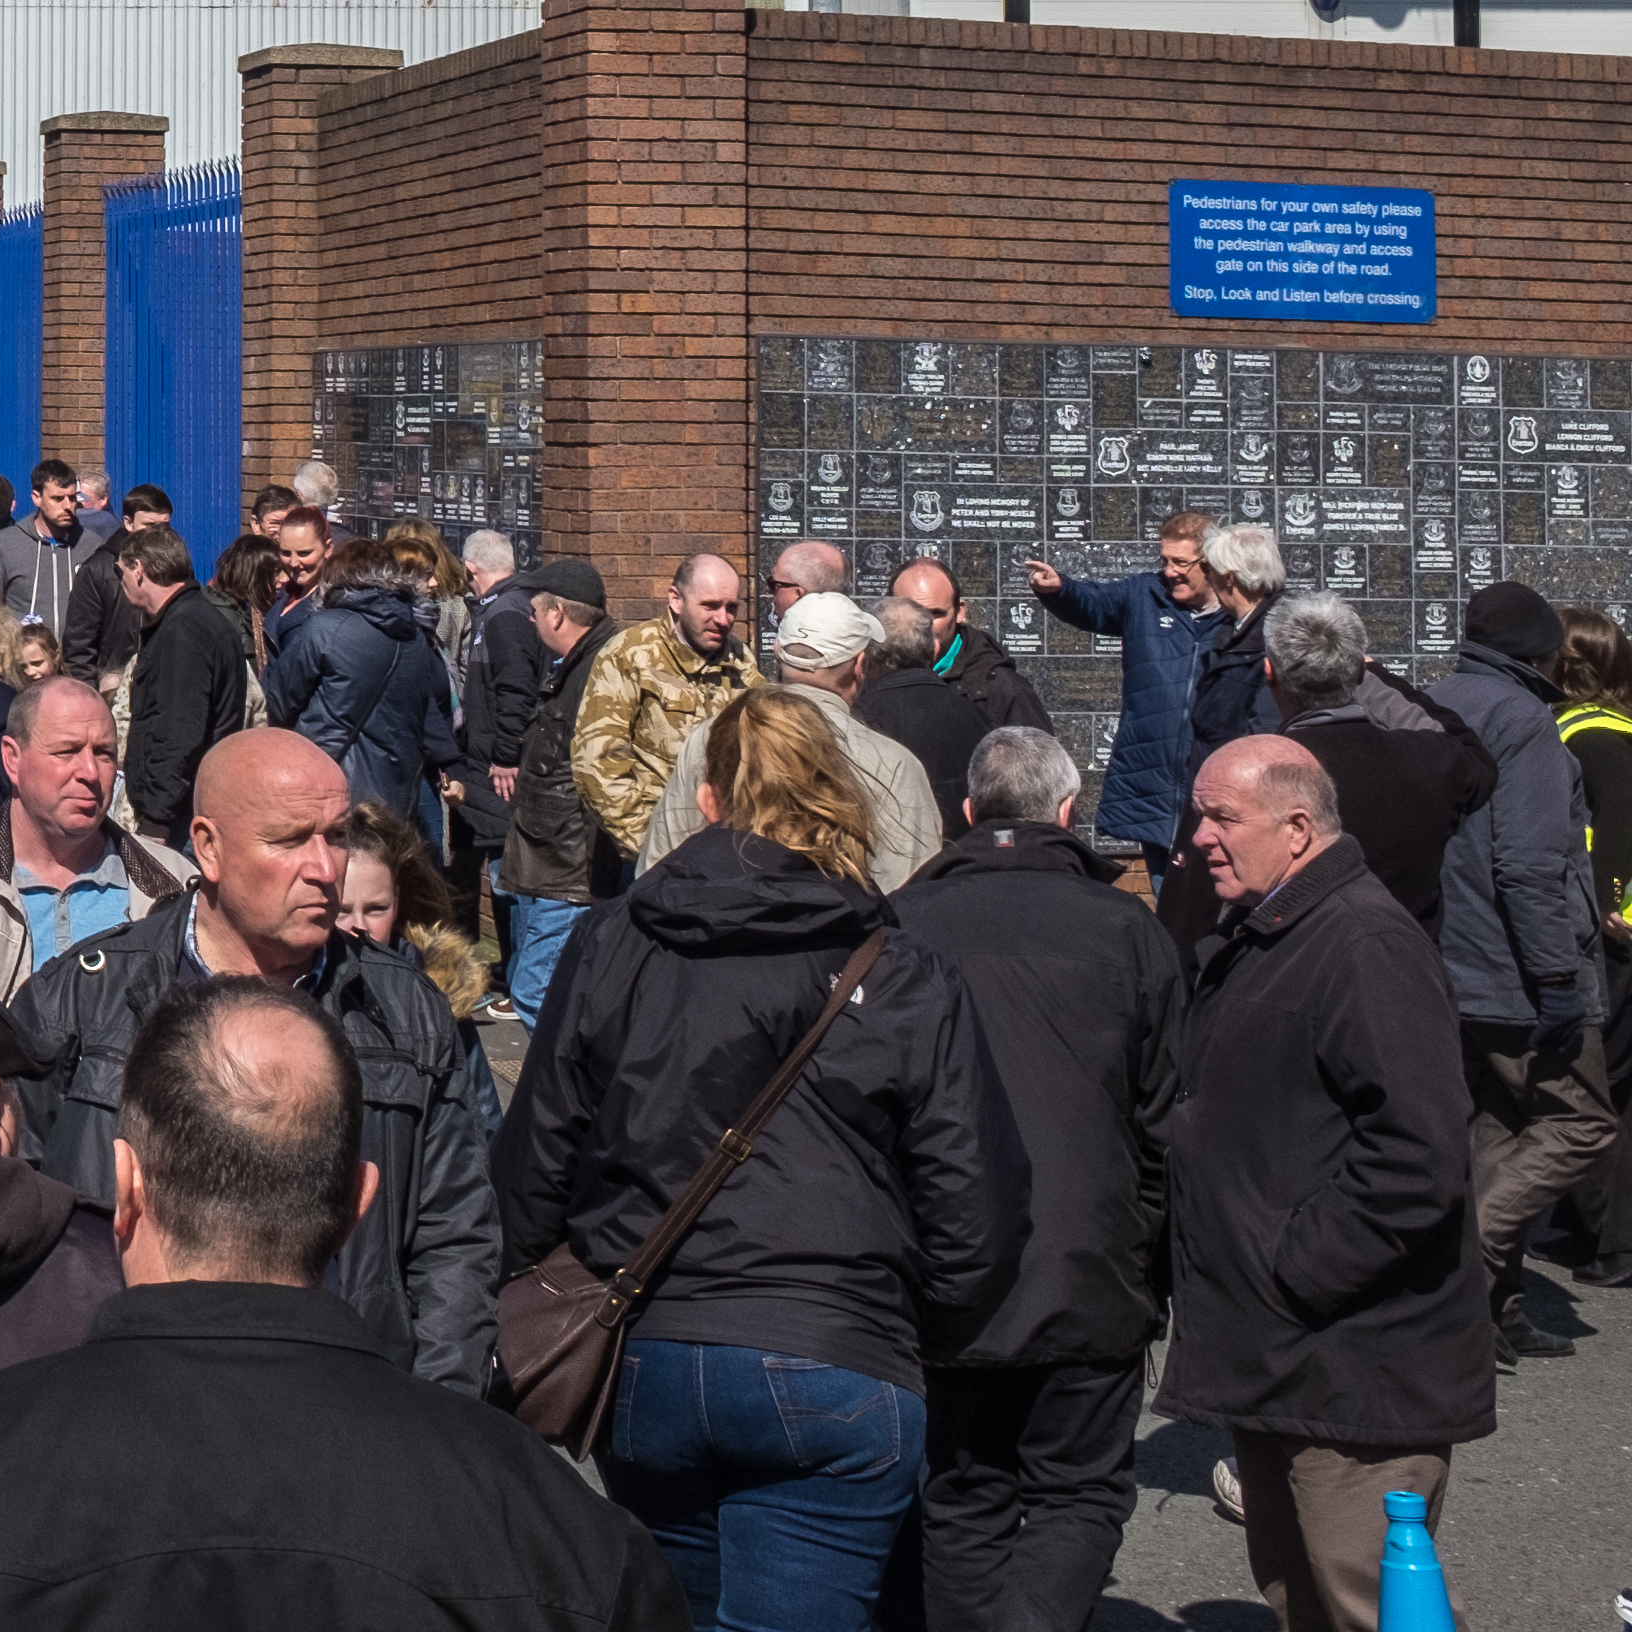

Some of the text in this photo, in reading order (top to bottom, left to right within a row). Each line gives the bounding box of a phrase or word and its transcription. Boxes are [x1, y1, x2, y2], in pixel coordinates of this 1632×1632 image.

[1183, 194, 1422, 218] Pedestrians for your own safety please
[1199, 218, 1408, 240] access the car park area by using
[1194, 236, 1413, 257] the pedestrian walkway and access
[1216, 258, 1392, 276] gate on this side of the road.
[1221, 286, 1252, 300] Look
[1256, 287, 1280, 301] and
[1283, 287, 1320, 303] Listen
[1323, 288, 1364, 304] before
